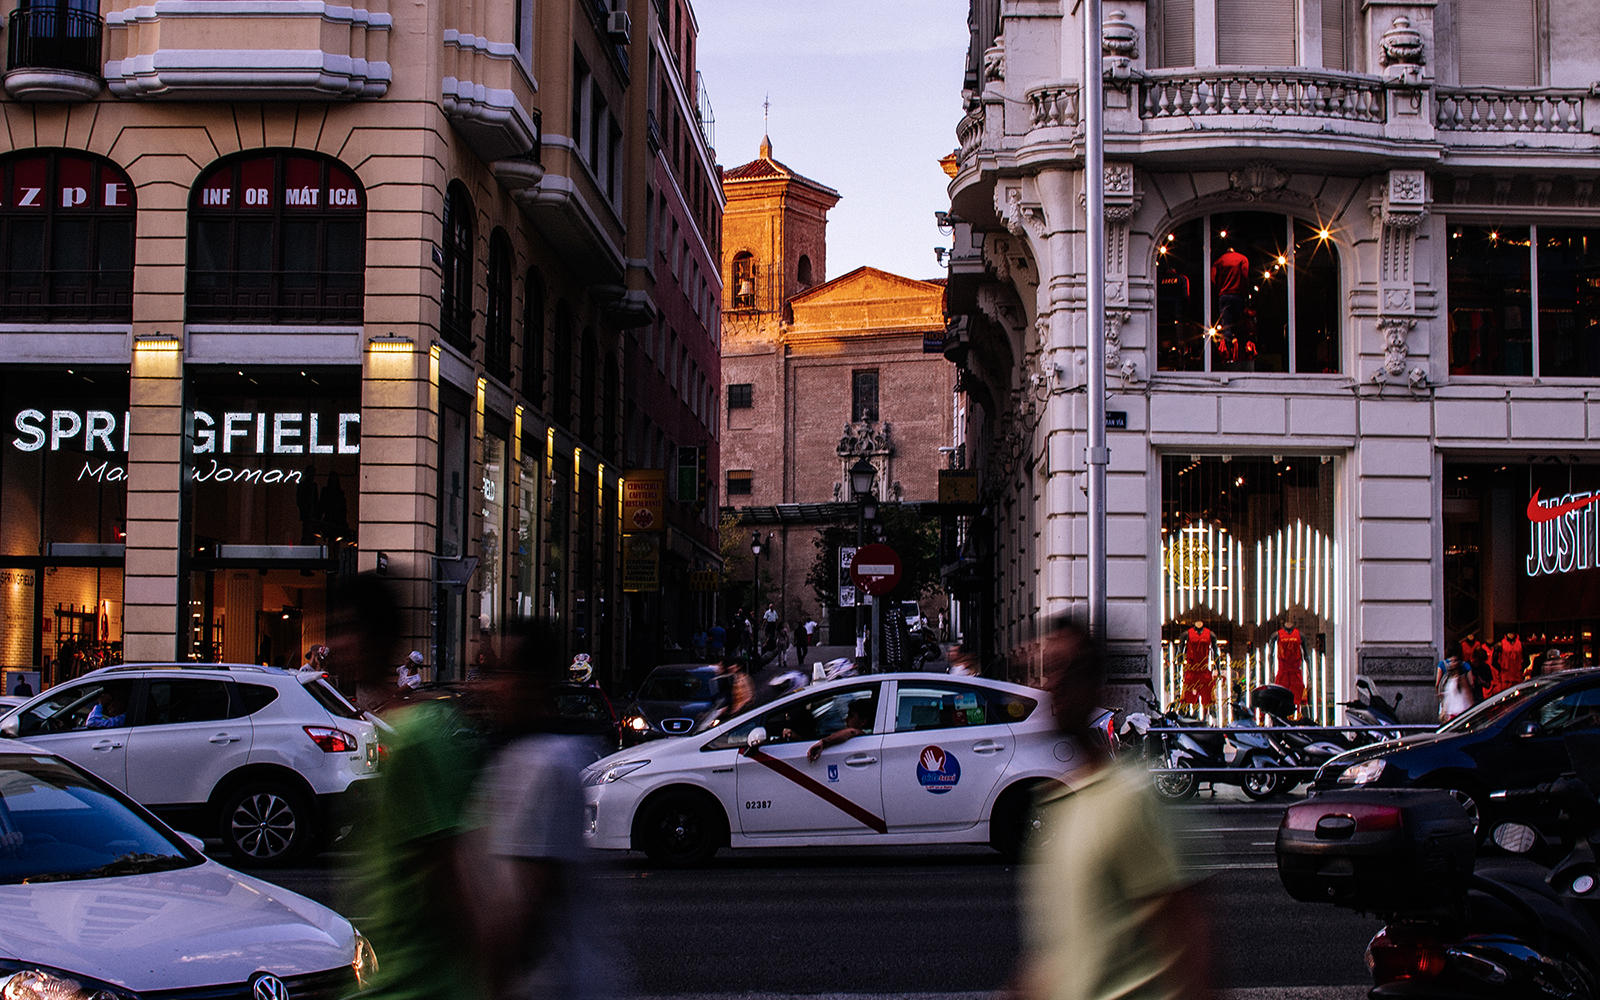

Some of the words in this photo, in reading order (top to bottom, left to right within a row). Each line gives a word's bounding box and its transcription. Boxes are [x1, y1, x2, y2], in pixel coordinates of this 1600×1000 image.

[925, 332, 945, 340] HOS
[12, 408, 360, 454] SPRIGFIELD
[1526, 490, 1593, 577] JUST
[745, 801, 772, 809] 02387
